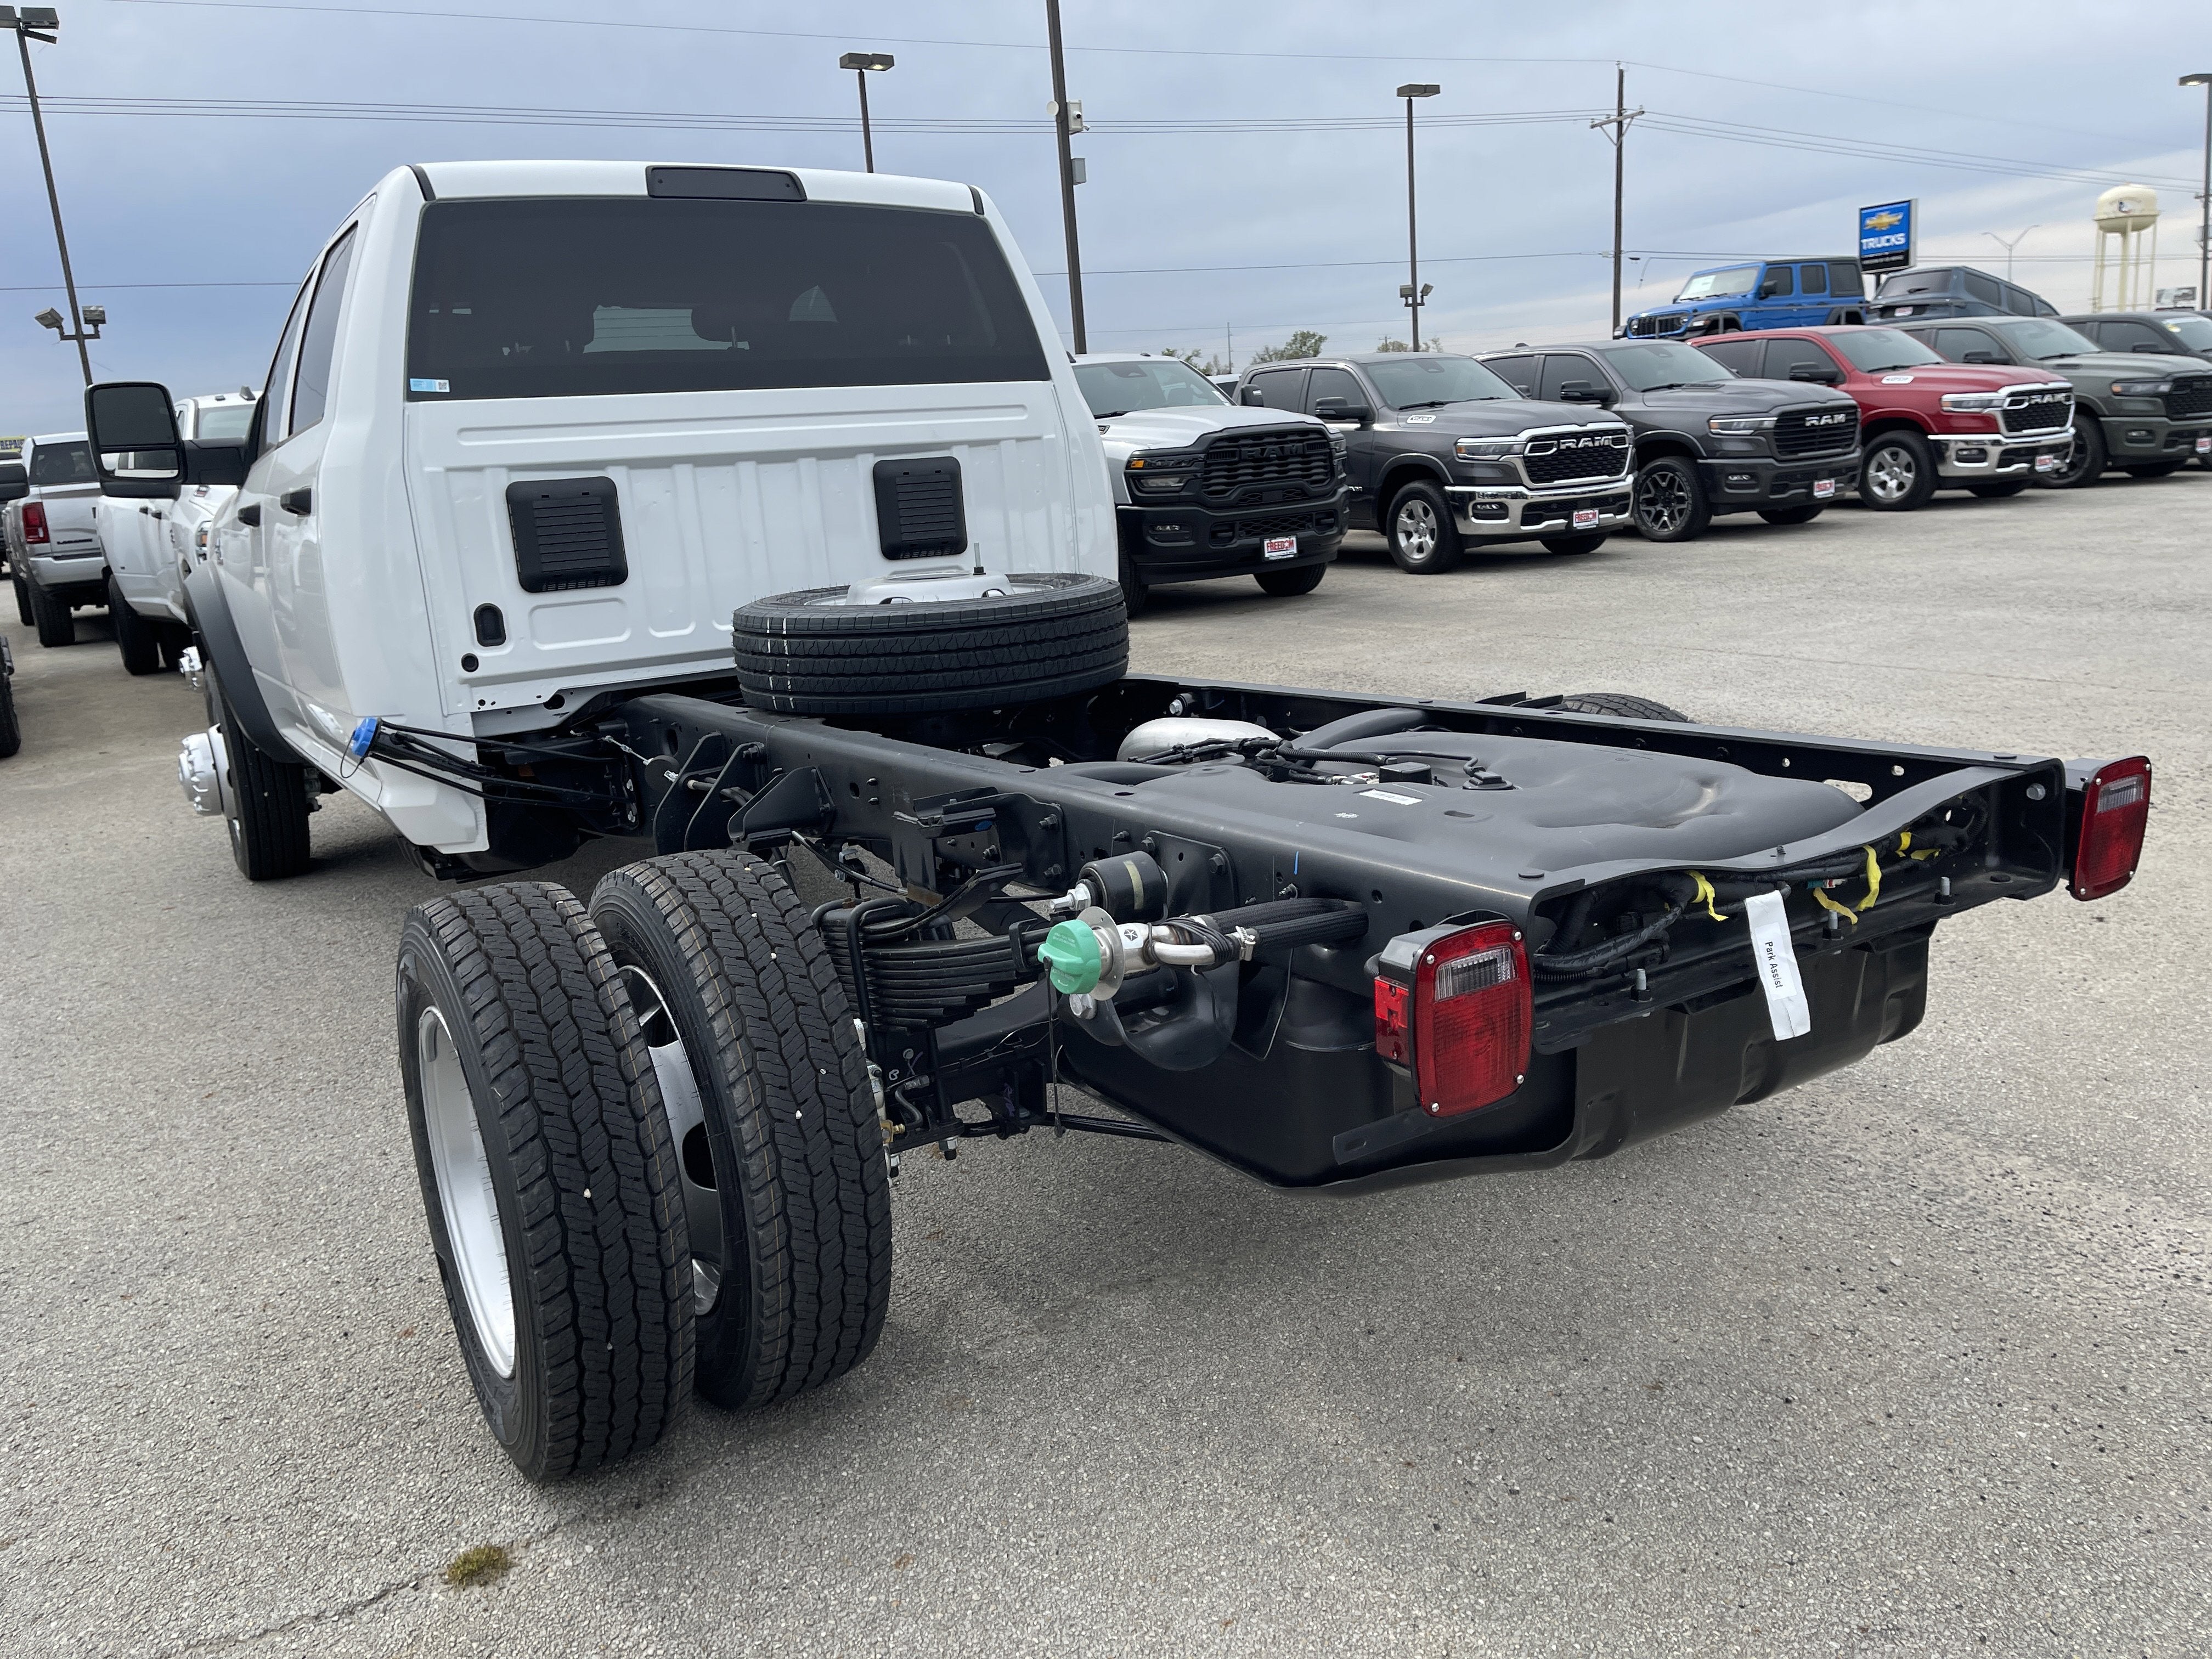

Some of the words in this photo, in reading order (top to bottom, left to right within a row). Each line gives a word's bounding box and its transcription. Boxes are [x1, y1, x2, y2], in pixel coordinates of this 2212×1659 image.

[1861, 233, 1906, 250] TRUCKS
[1805, 414, 1846, 427] RAM
[1560, 436, 1612, 449] RAM
[1240, 443, 1304, 459] RAM
[1765, 941, 1775, 961] Park
[1769, 963, 1784, 989] Assist
